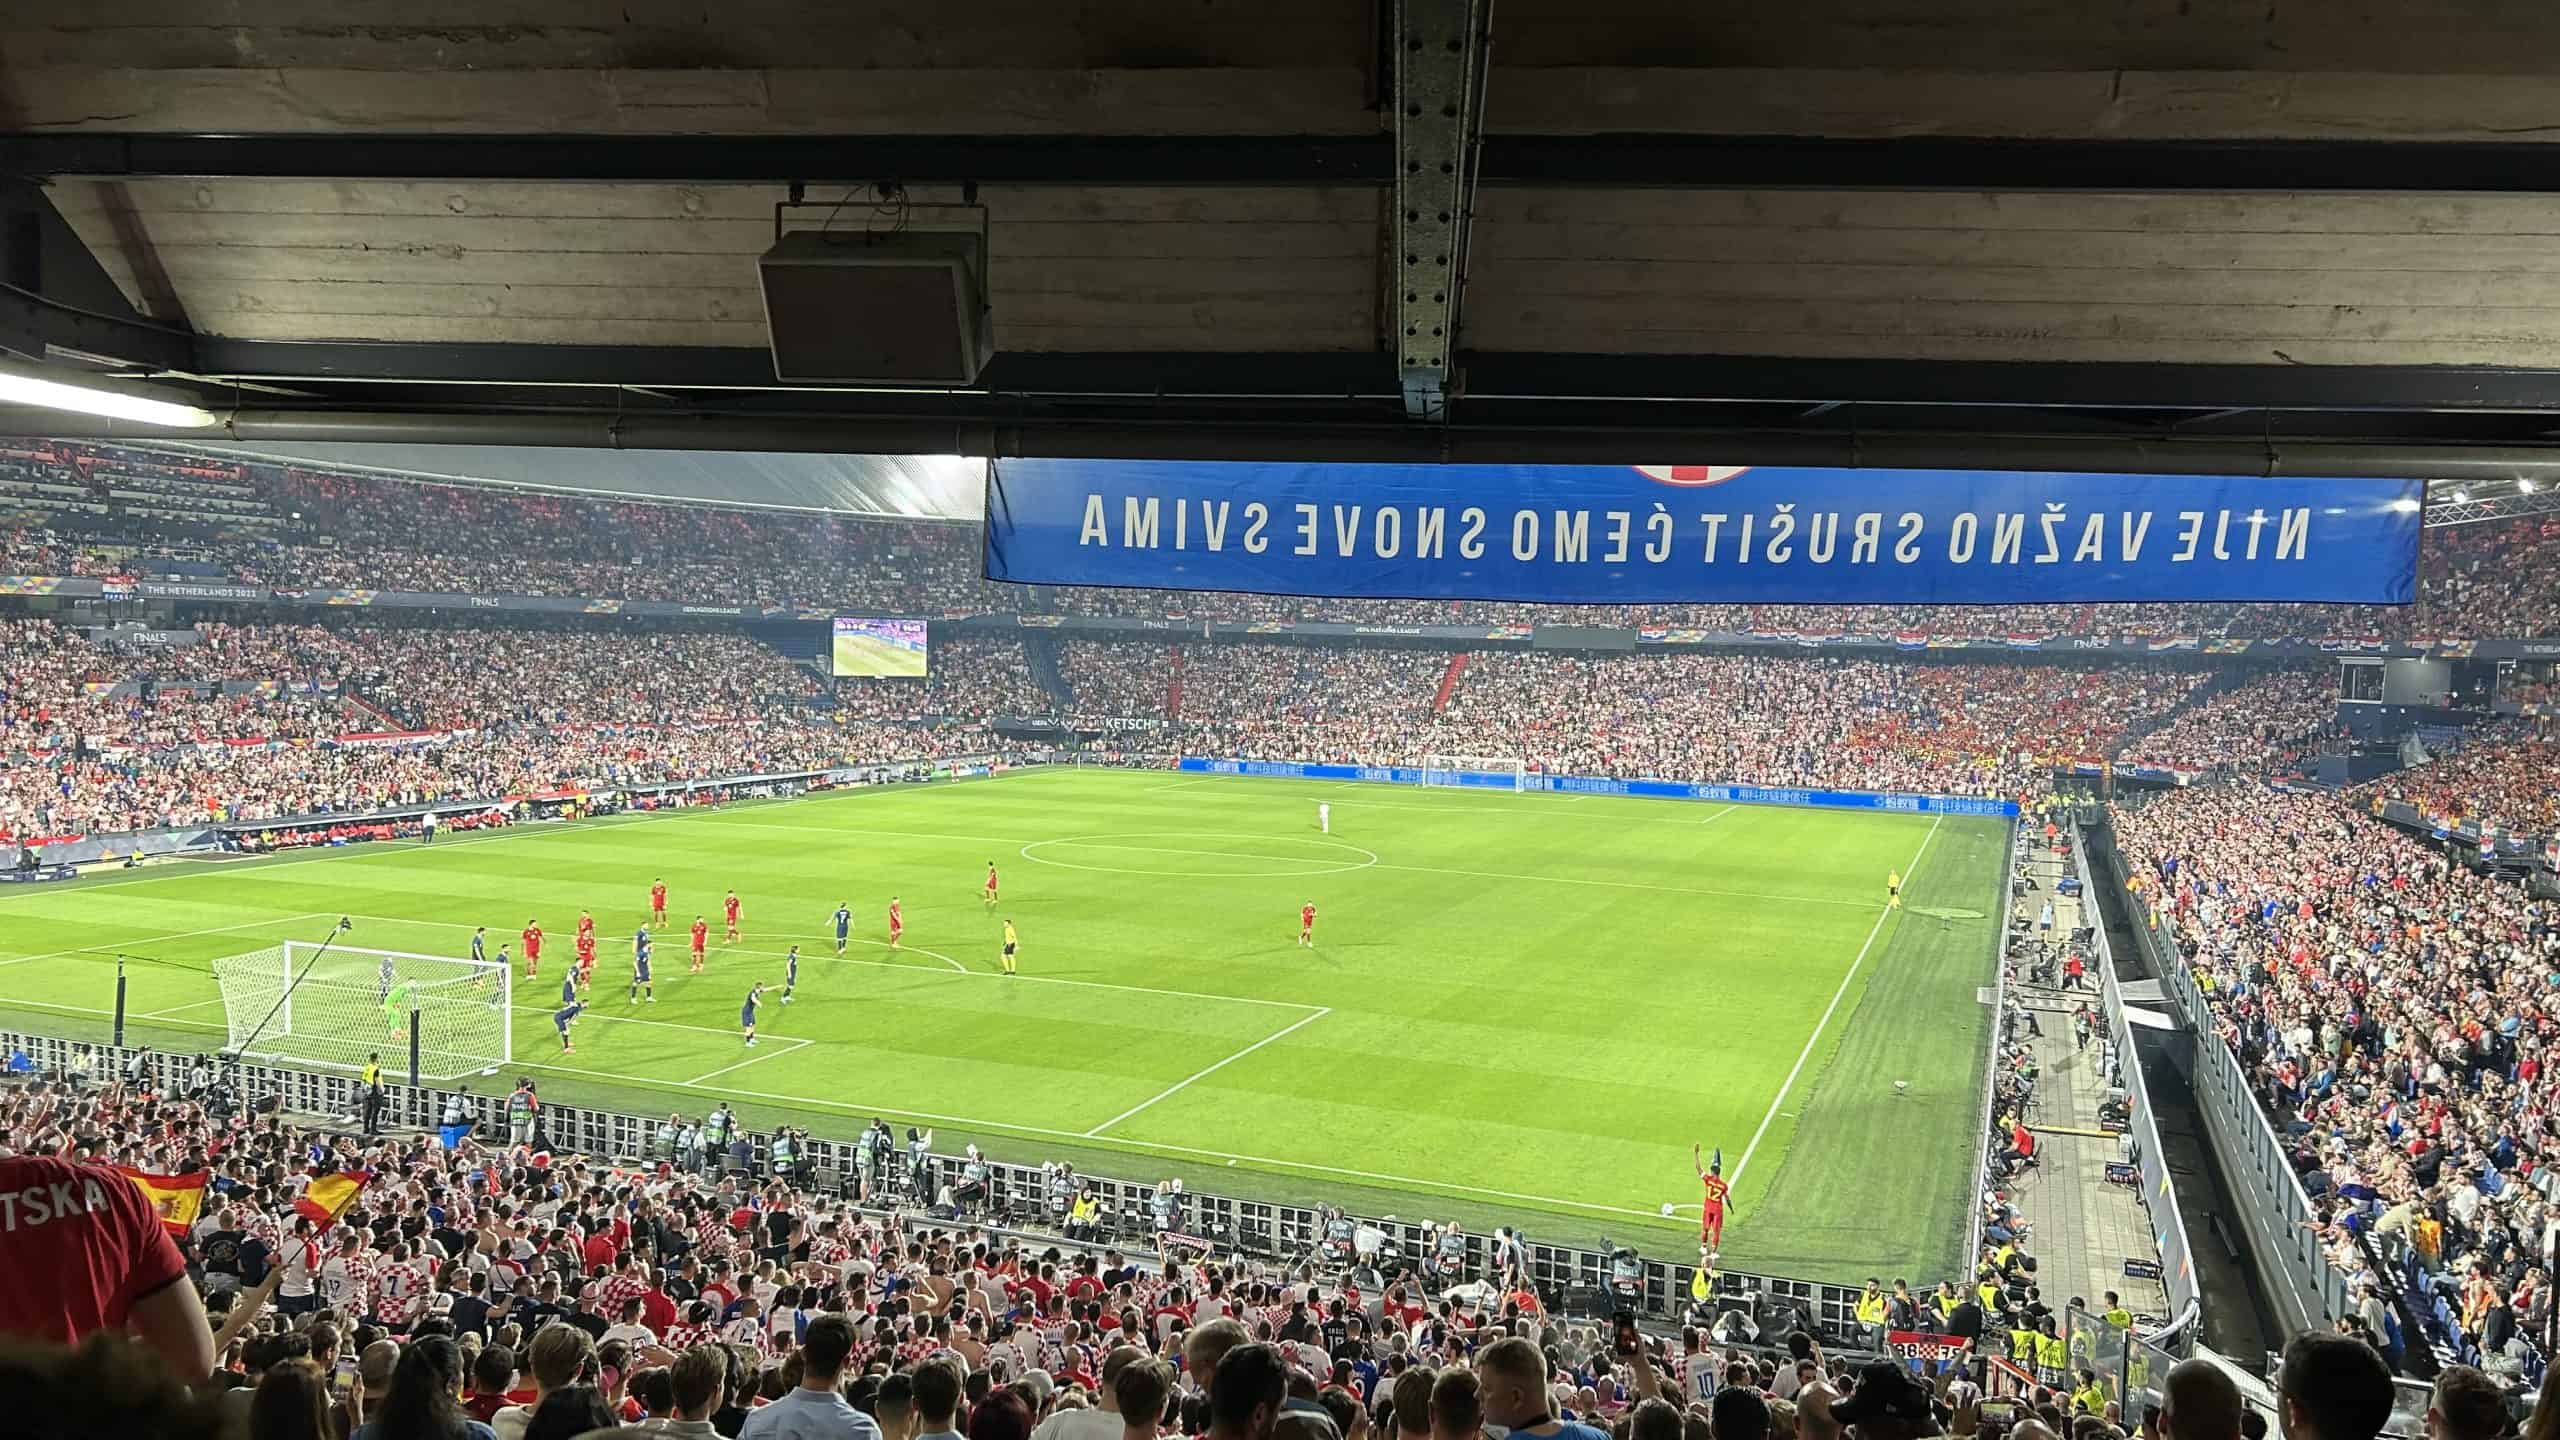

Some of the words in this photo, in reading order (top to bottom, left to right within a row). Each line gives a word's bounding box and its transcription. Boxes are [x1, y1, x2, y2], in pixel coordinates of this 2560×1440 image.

[148, 585, 166, 595] THE
[168, 587, 233, 597] NETHERLANDS
[471, 597, 499, 607] FINALS
[132, 631, 168, 642] FINALS
[1706, 1185, 1723, 1202] 12
[0, 1178, 109, 1233] TSKA
[387, 1275, 399, 1296] 7
[1696, 1372, 1715, 1400] 10
